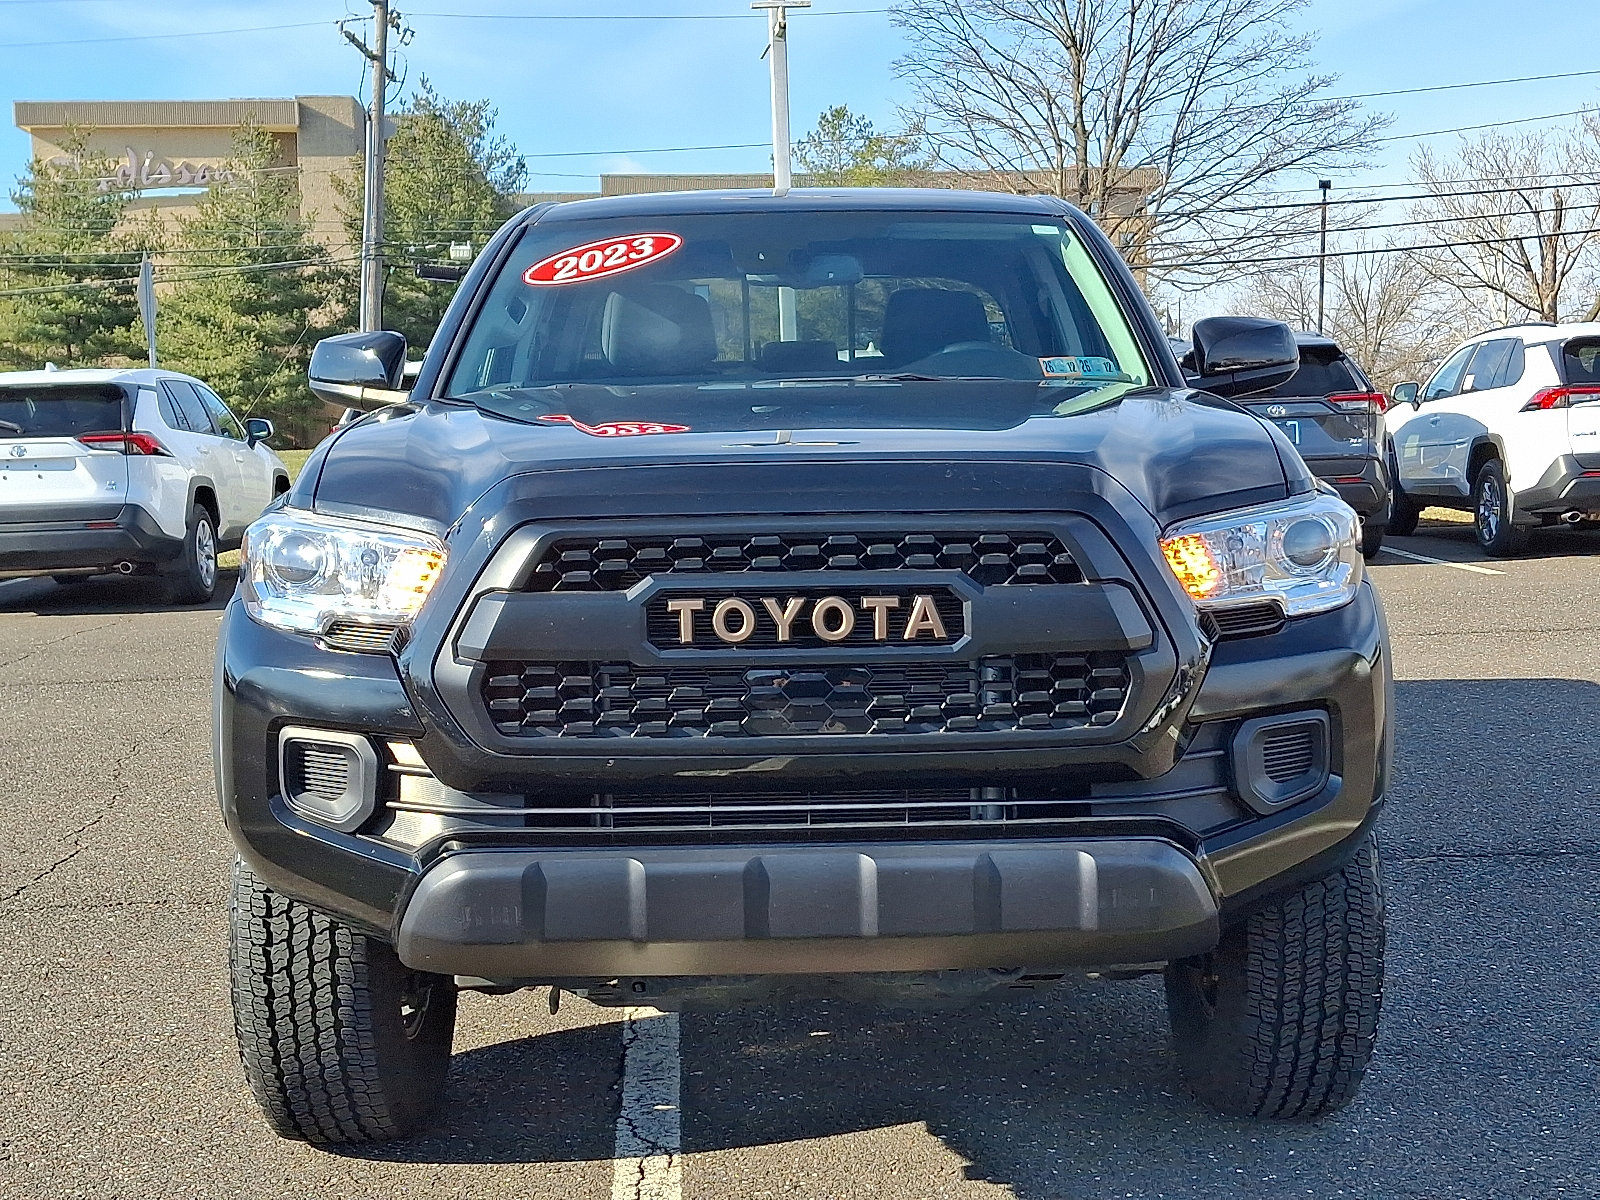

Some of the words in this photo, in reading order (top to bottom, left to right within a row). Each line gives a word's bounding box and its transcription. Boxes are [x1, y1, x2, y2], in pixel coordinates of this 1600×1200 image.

[553, 237, 654, 281] 2023
[1042, 360, 1055, 373] 26
[1067, 361, 1078, 373] 12
[1080, 360, 1092, 373] 26
[1103, 361, 1113, 373] 12
[667, 594, 948, 643] TOYOTA
